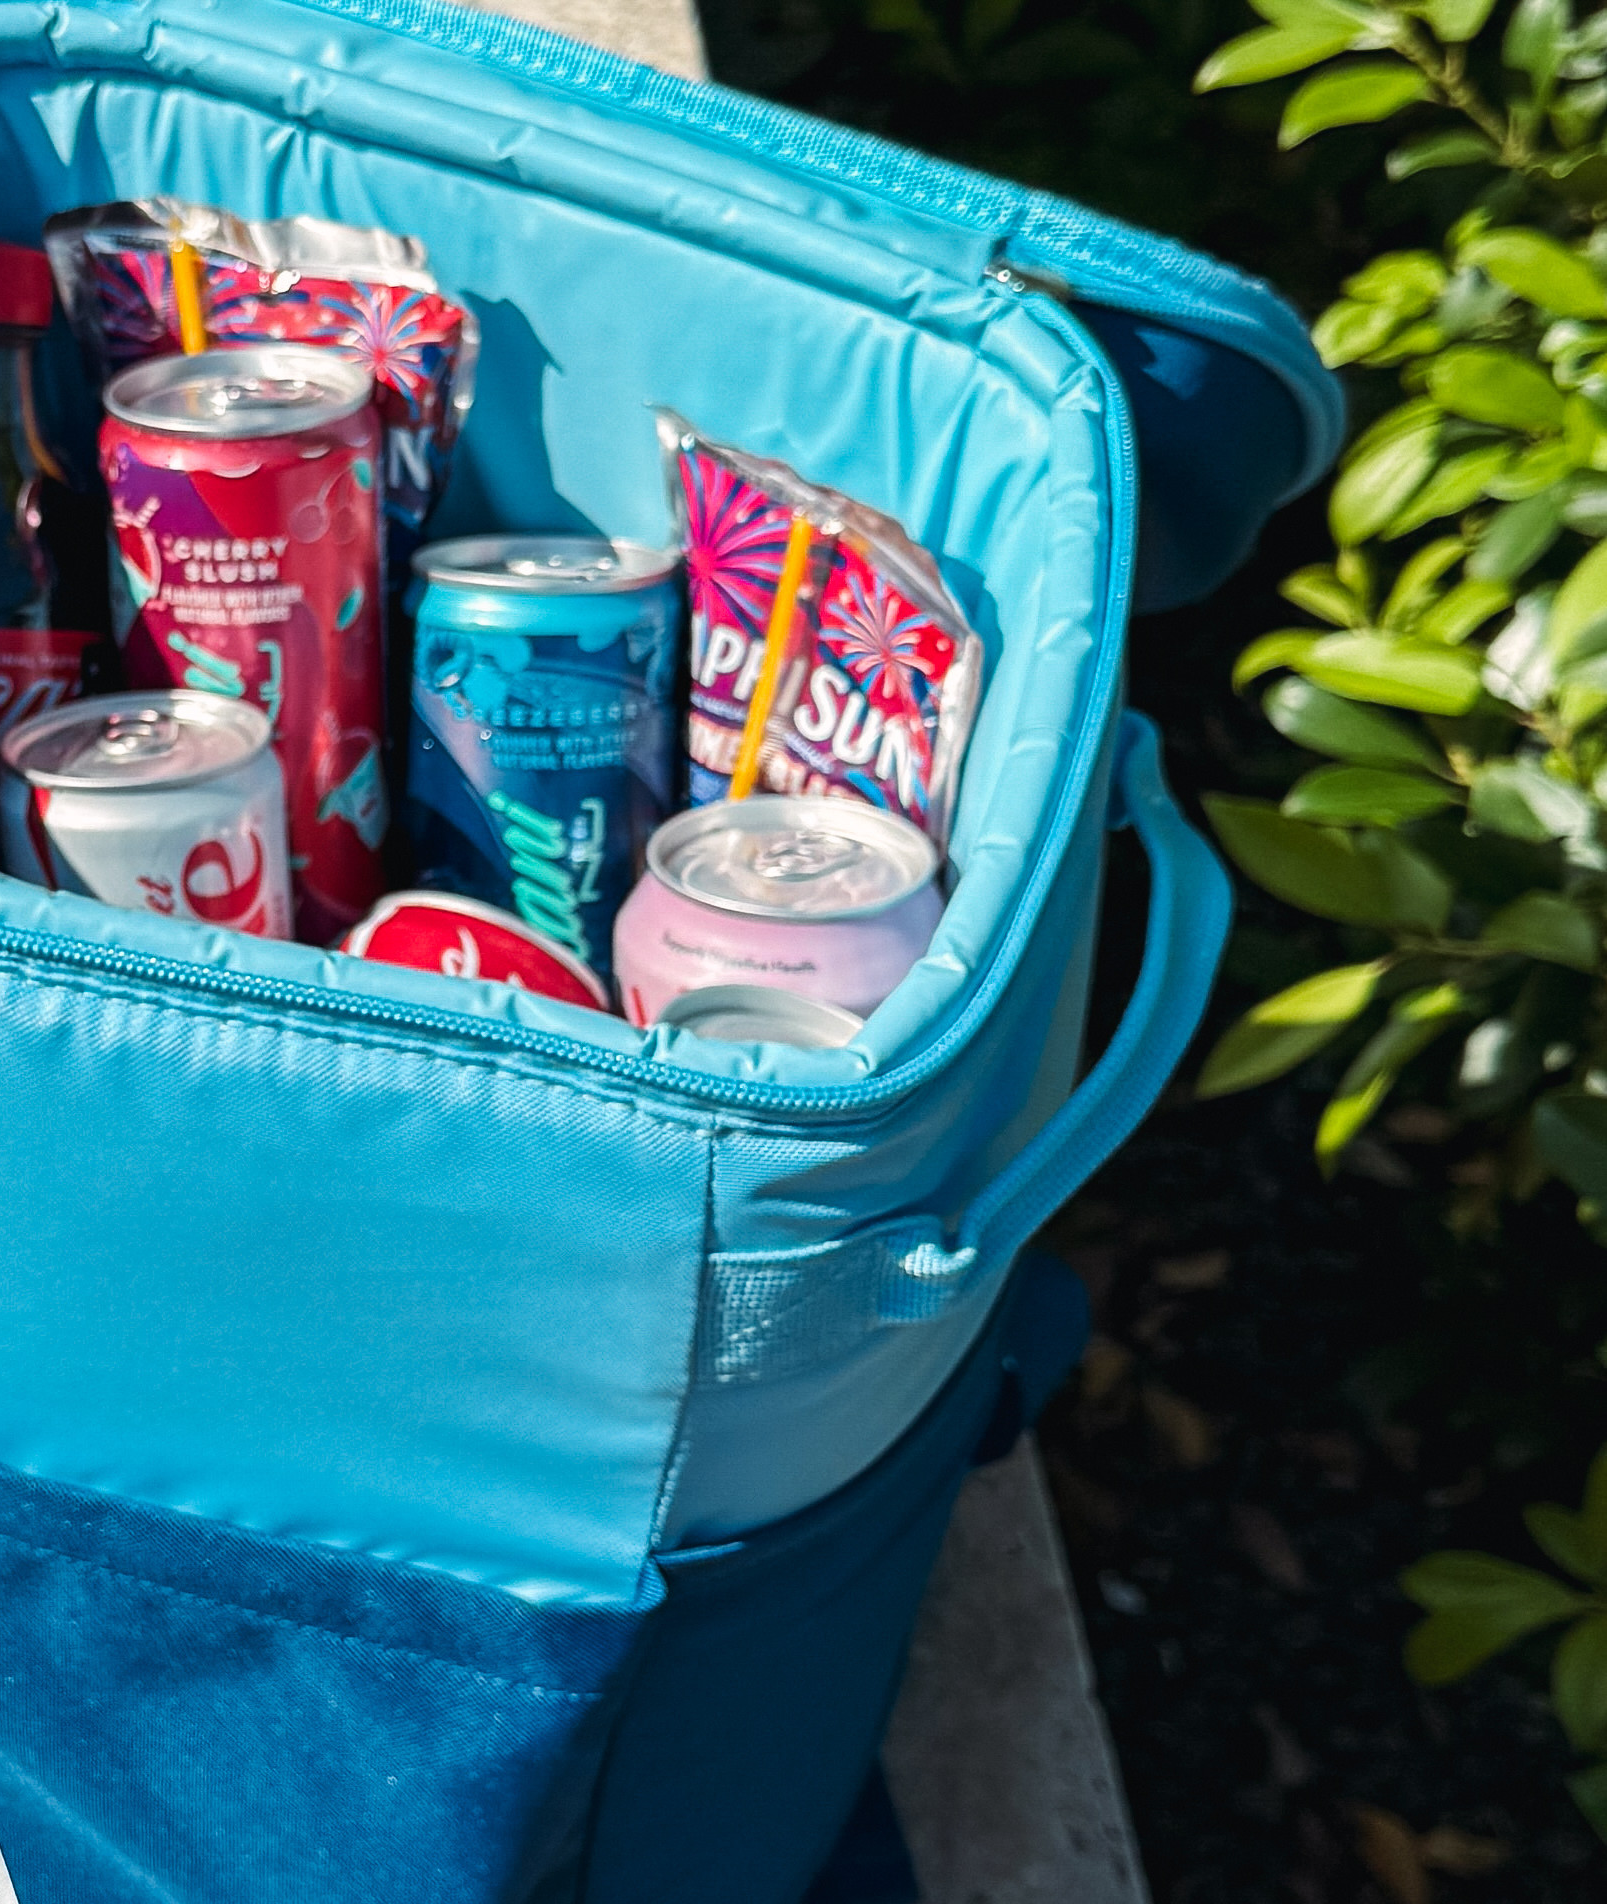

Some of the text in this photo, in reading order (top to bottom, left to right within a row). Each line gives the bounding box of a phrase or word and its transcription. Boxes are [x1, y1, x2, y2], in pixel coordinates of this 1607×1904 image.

[173, 537, 289, 563] CHERRY
[184, 561, 279, 584] SLUSH
[794, 663, 918, 810] SUN
